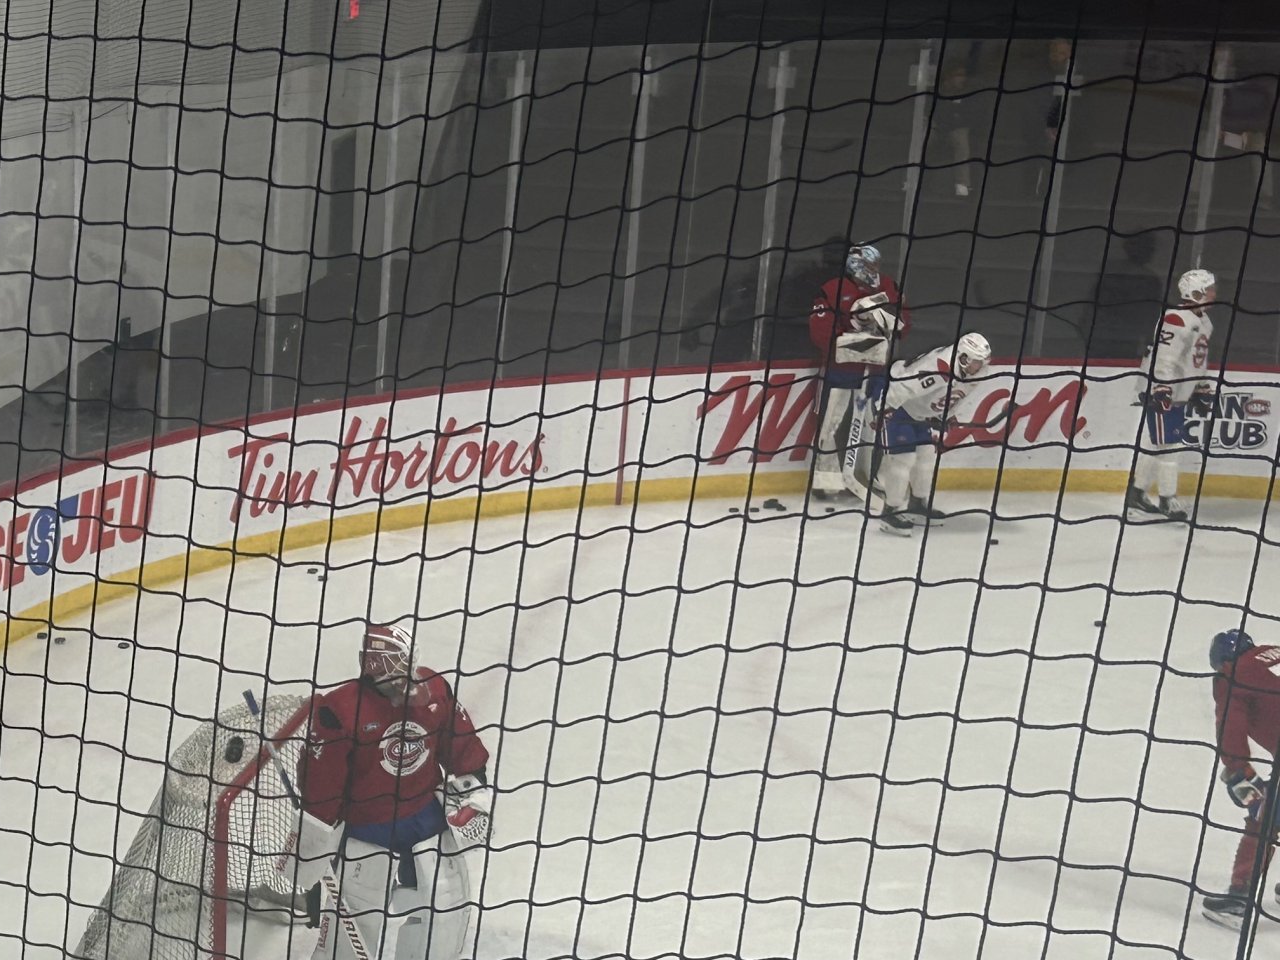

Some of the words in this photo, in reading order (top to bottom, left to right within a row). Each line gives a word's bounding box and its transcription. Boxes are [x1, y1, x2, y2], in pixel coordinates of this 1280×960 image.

[1183, 420, 1268, 450] CLUB
[227, 431, 320, 524] Tim
[326, 416, 546, 501] Hortons
